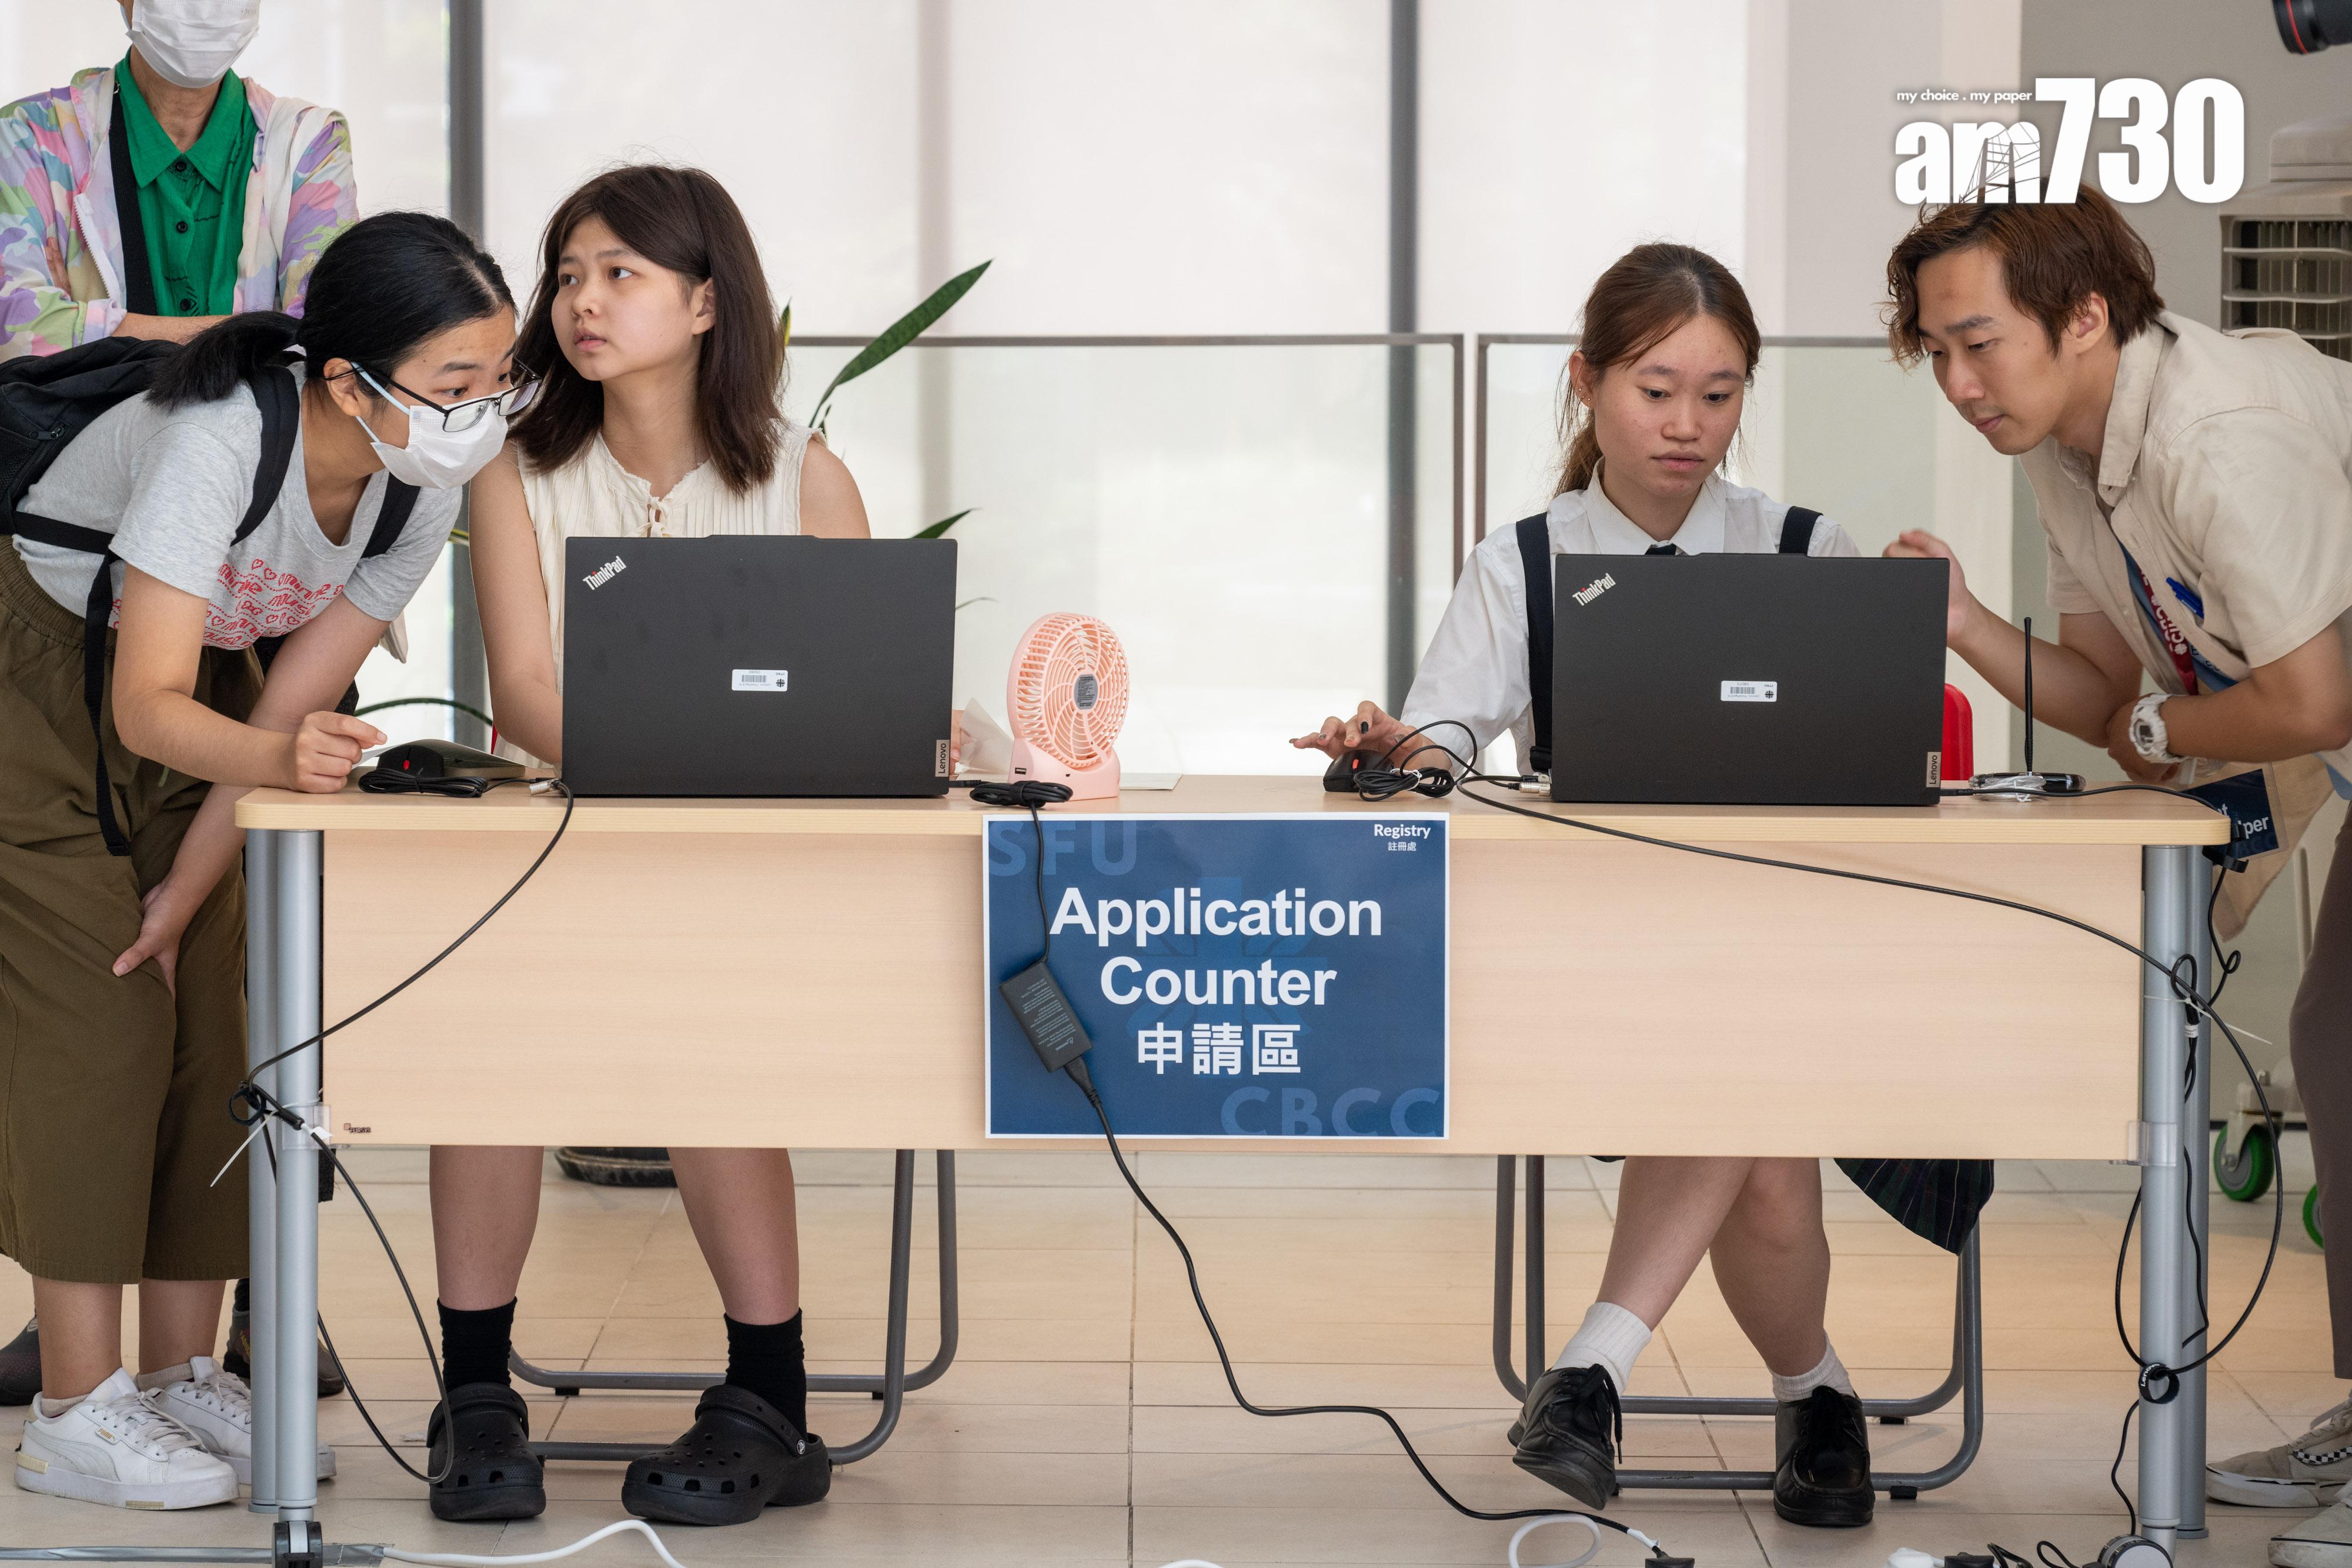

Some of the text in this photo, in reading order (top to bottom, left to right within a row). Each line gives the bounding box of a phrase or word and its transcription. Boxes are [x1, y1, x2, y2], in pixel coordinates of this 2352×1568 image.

[582, 555, 627, 590] ThinkPad
[1572, 573, 1616, 606] ThinkPad
[938, 743, 947, 774] Lenovo
[1929, 755, 1937, 784] Lenovo
[1374, 824, 1431, 840] Registry
[2237, 816, 2269, 840] per
[988, 821, 1137, 877] SFU
[1388, 841, 1416, 851] 註冊處
[1049, 887, 1381, 947] Application
[1101, 956, 1337, 1006] Counter
[1138, 1022, 1301, 1075] 申請區
[1220, 1086, 1440, 1136] CBCC
[2140, 1363, 2160, 1388] Lenovo
